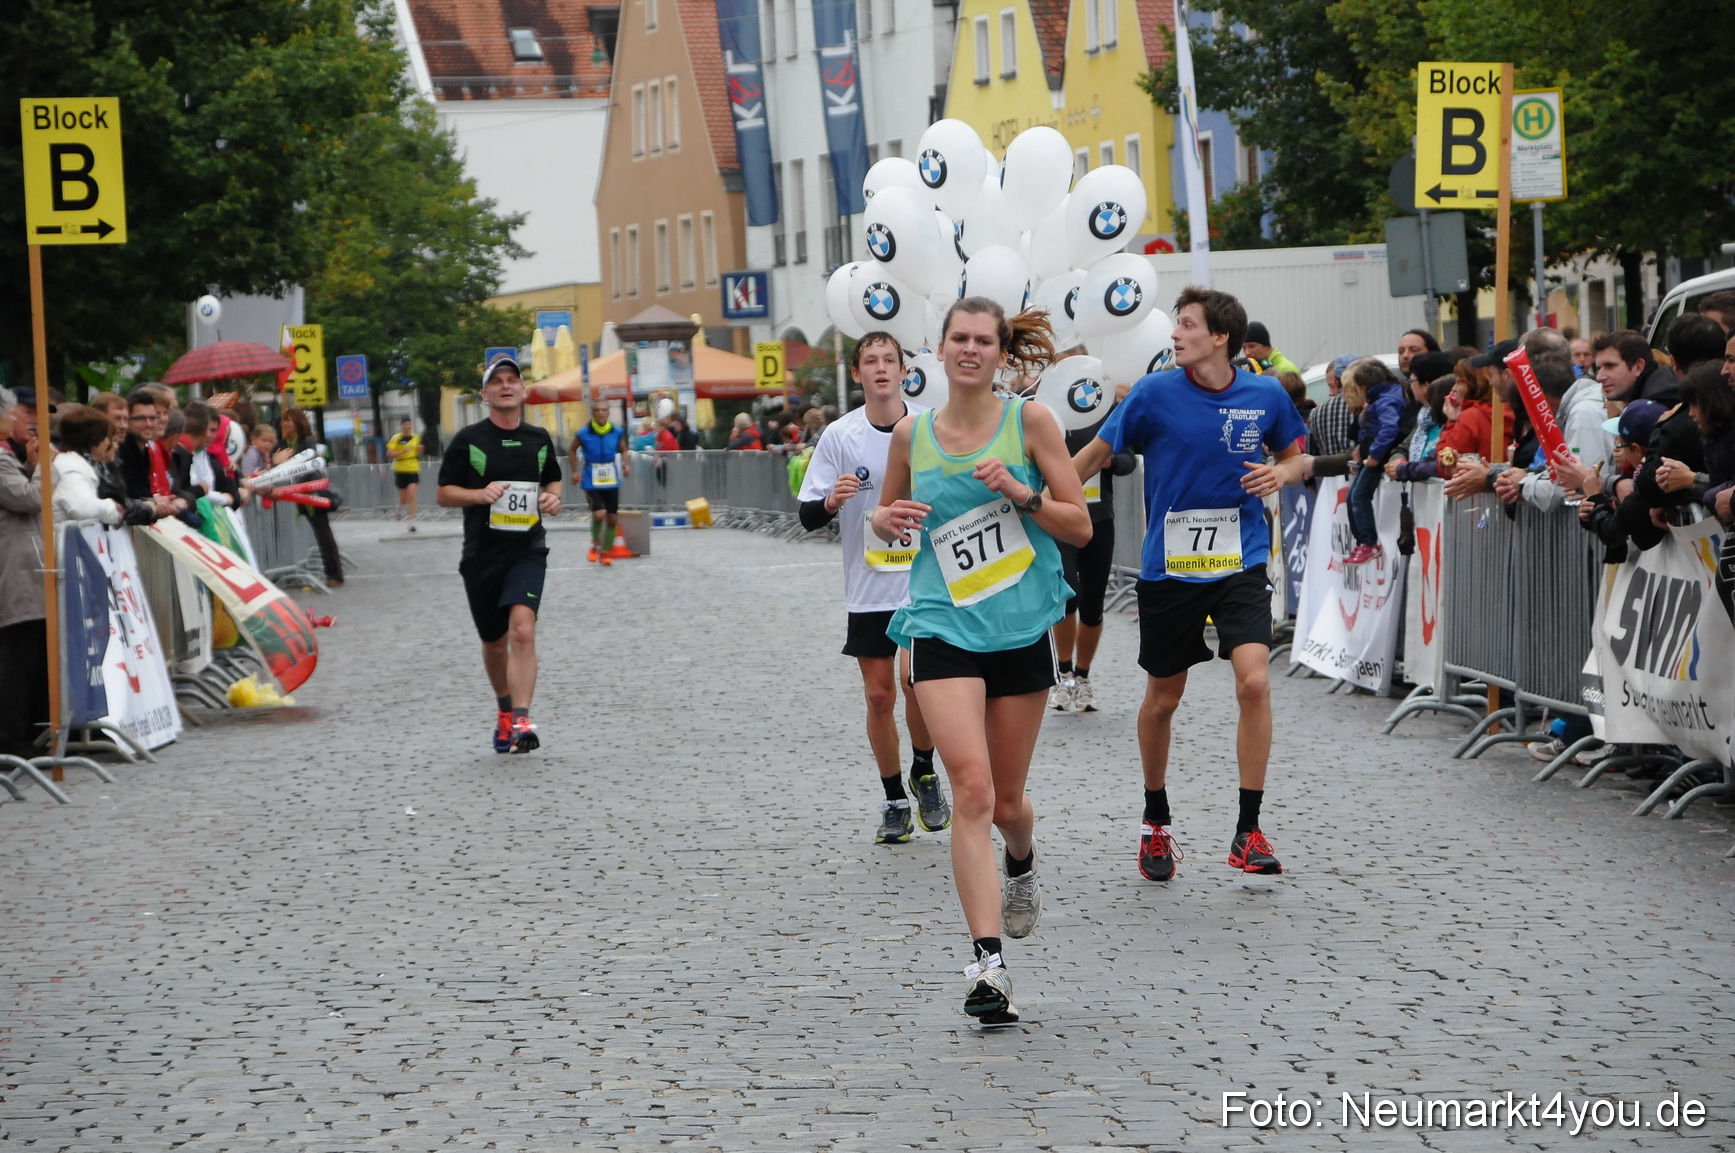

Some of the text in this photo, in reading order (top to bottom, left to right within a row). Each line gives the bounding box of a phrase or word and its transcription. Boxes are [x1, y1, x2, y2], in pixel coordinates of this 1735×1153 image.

[1430, 69, 1502, 94] Block
[33, 104, 109, 130] Block
[1523, 107, 1544, 130] H
[1441, 107, 1487, 175] B
[49, 142, 99, 211] B
[294, 344, 311, 373] C
[757, 344, 782, 352] Block
[762, 355, 778, 377] D
[342, 384, 365, 395] TAXI
[1517, 364, 1558, 433] Audi BKK
[508, 494, 528, 511] 84
[503, 516, 530, 524] Thomas
[933, 510, 999, 547] PARTL Neumarkt
[1166, 516, 1191, 525] PARTL
[951, 521, 1005, 571] 577
[1188, 527, 1218, 551] 77
[884, 553, 913, 563] Jannik
